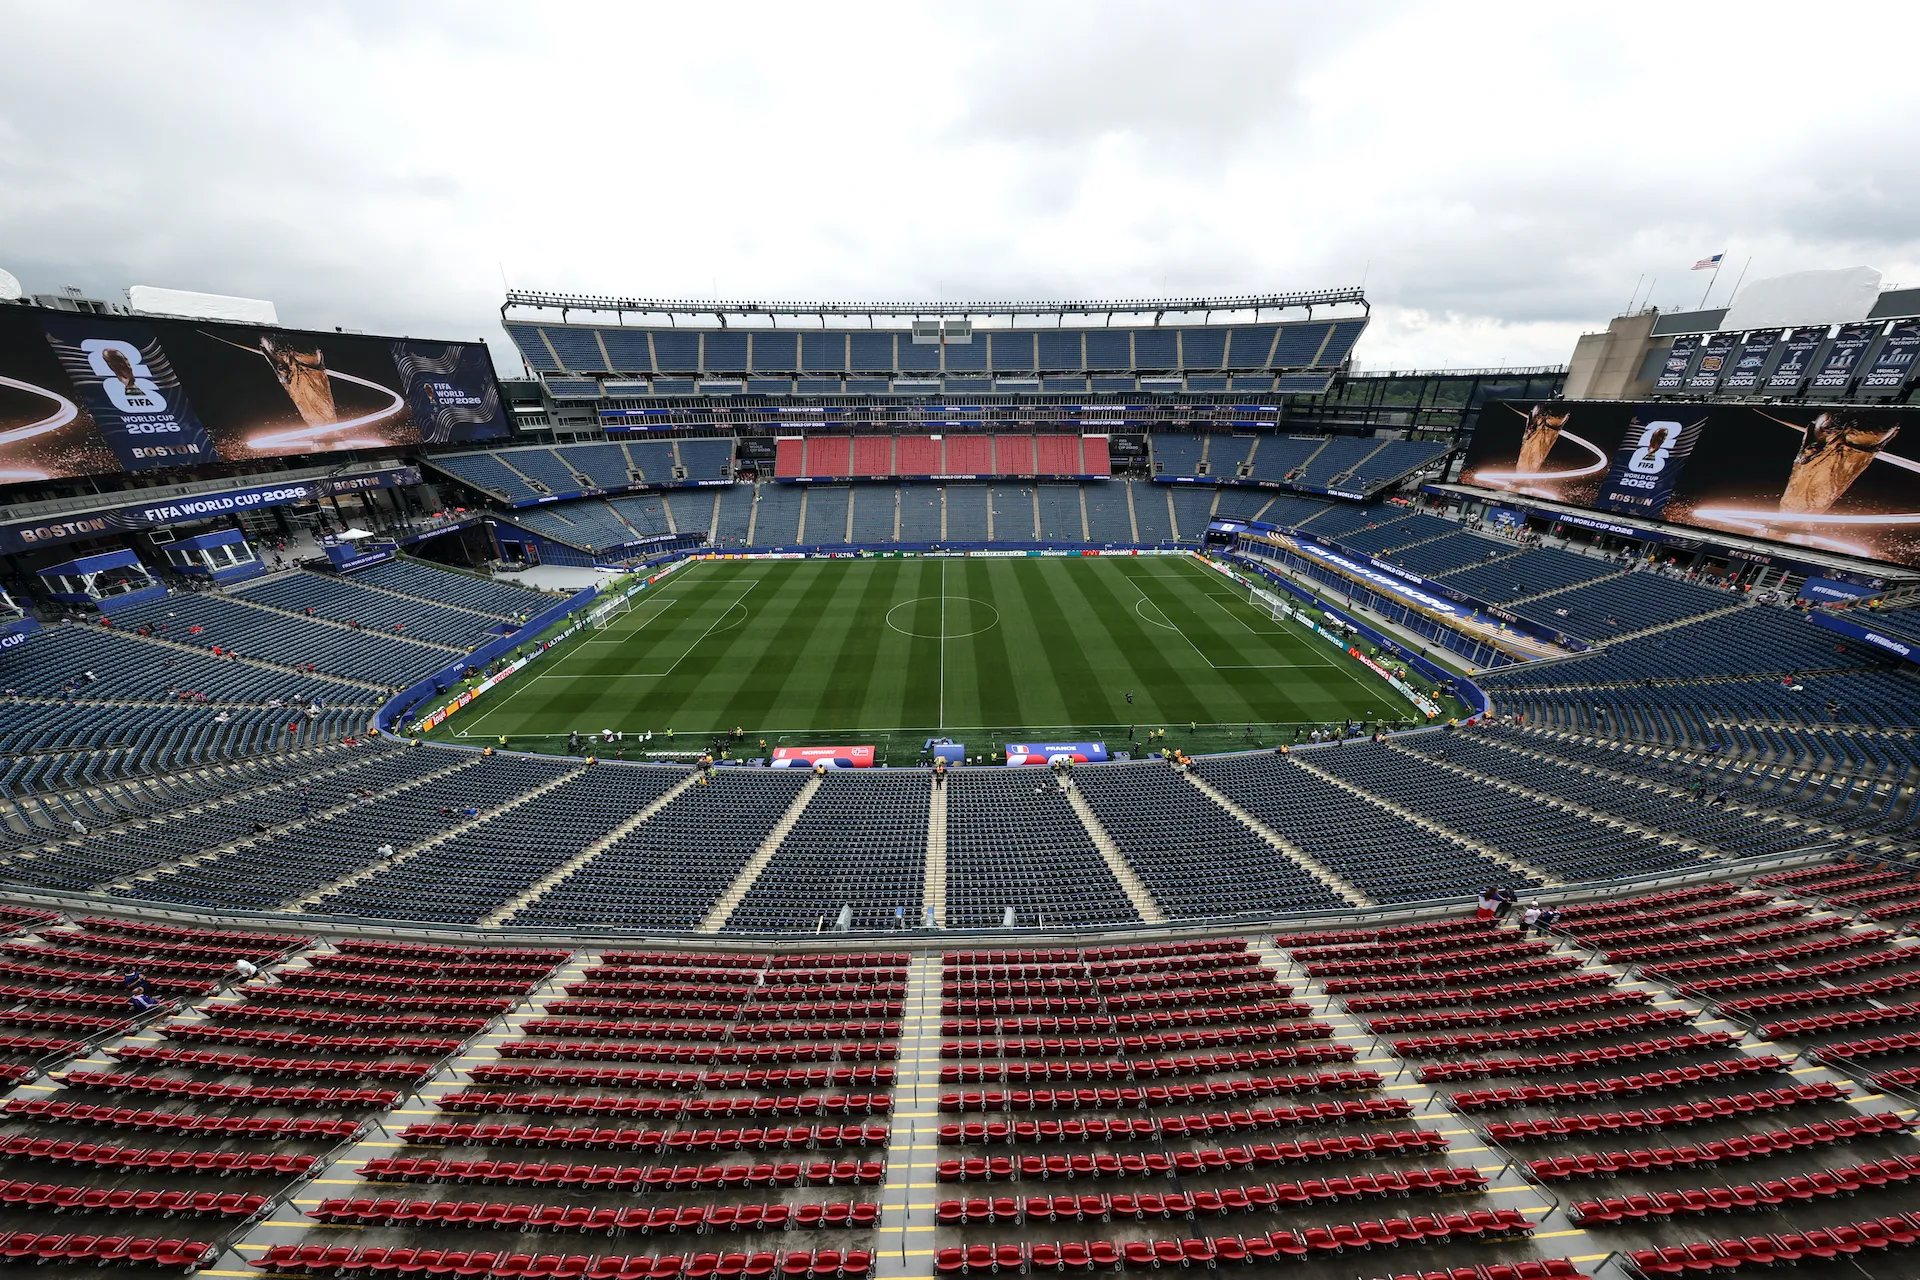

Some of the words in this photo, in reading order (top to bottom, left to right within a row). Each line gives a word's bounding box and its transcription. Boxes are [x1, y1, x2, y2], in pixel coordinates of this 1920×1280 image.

[126, 398, 154, 407] FIFA
[121, 414, 156, 423] WORLD
[126, 421, 181, 435] 2026
[131, 443, 201, 459] BOSTON
[1620, 478, 1656, 489] 2026
[1609, 493, 1653, 506] BOSTON
[19, 517, 106, 544] BOSTON
[144, 504, 182, 522] FIFA
[181, 496, 235, 515] WORLD
[235, 493, 262, 507] CUP
[262, 487, 308, 501] 2026
[333, 476, 381, 491] BOSTON
[1572, 516, 1595, 527] WORLD
[1594, 520, 1609, 530] CUP
[1608, 525, 1634, 535] 2026
[1727, 549, 1771, 564] BOSTON
[1371, 559, 1380, 567] FIFA
[1380, 562, 1396, 574] WORLD
[1395, 569, 1406, 577] CUP
[1, 633, 26, 648] CUP
[548, 634, 565, 647] ULTRA
[1317, 626, 1344, 649] Hisense
[453, 663, 464, 671] FIFA
[1359, 655, 1390, 680] McDonald's
[493, 666, 516, 684] verizon
